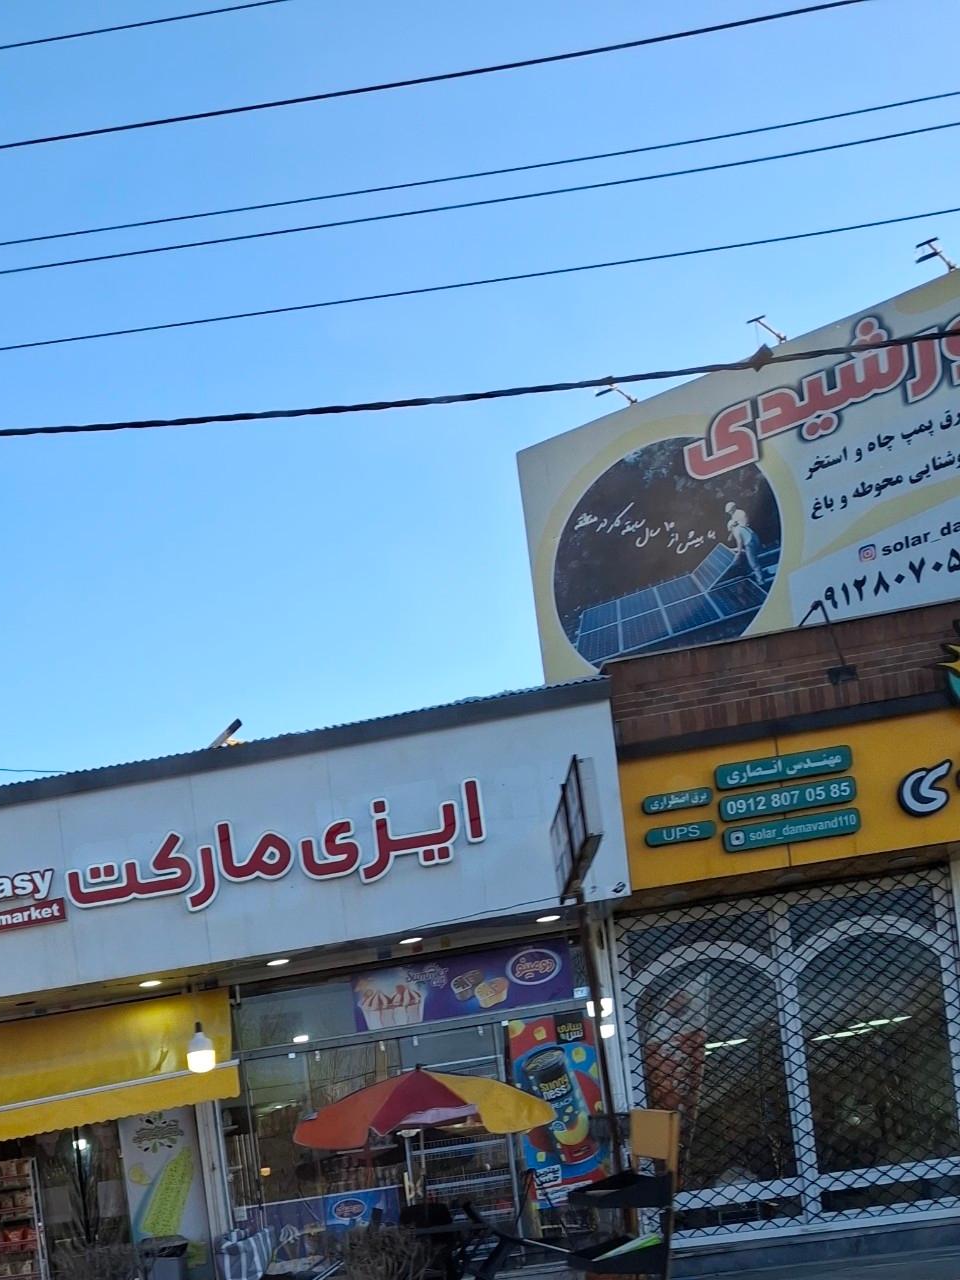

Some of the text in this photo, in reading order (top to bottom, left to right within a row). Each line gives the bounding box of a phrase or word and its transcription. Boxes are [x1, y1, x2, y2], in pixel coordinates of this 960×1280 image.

[867, 433, 895, 452] چاه
[900, 419, 934, 446] پمپ
[805, 446, 848, 480] استخر
[854, 448, 863, 462] و
[852, 474, 903, 498] محوطه
[810, 495, 834, 520] باغ
[839, 494, 848, 510] و
[824, 547, 960, 610] ۹۱۲۸۰۷۰۵
[726, 754, 842, 785] مهندس انصاری
[726, 781, 851, 815] 0912 807 05 85
[662, 823, 701, 842] UPS
[749, 813, 857, 841] solar_damavand110
[66, 778, 487, 912] ایزی مارکت
